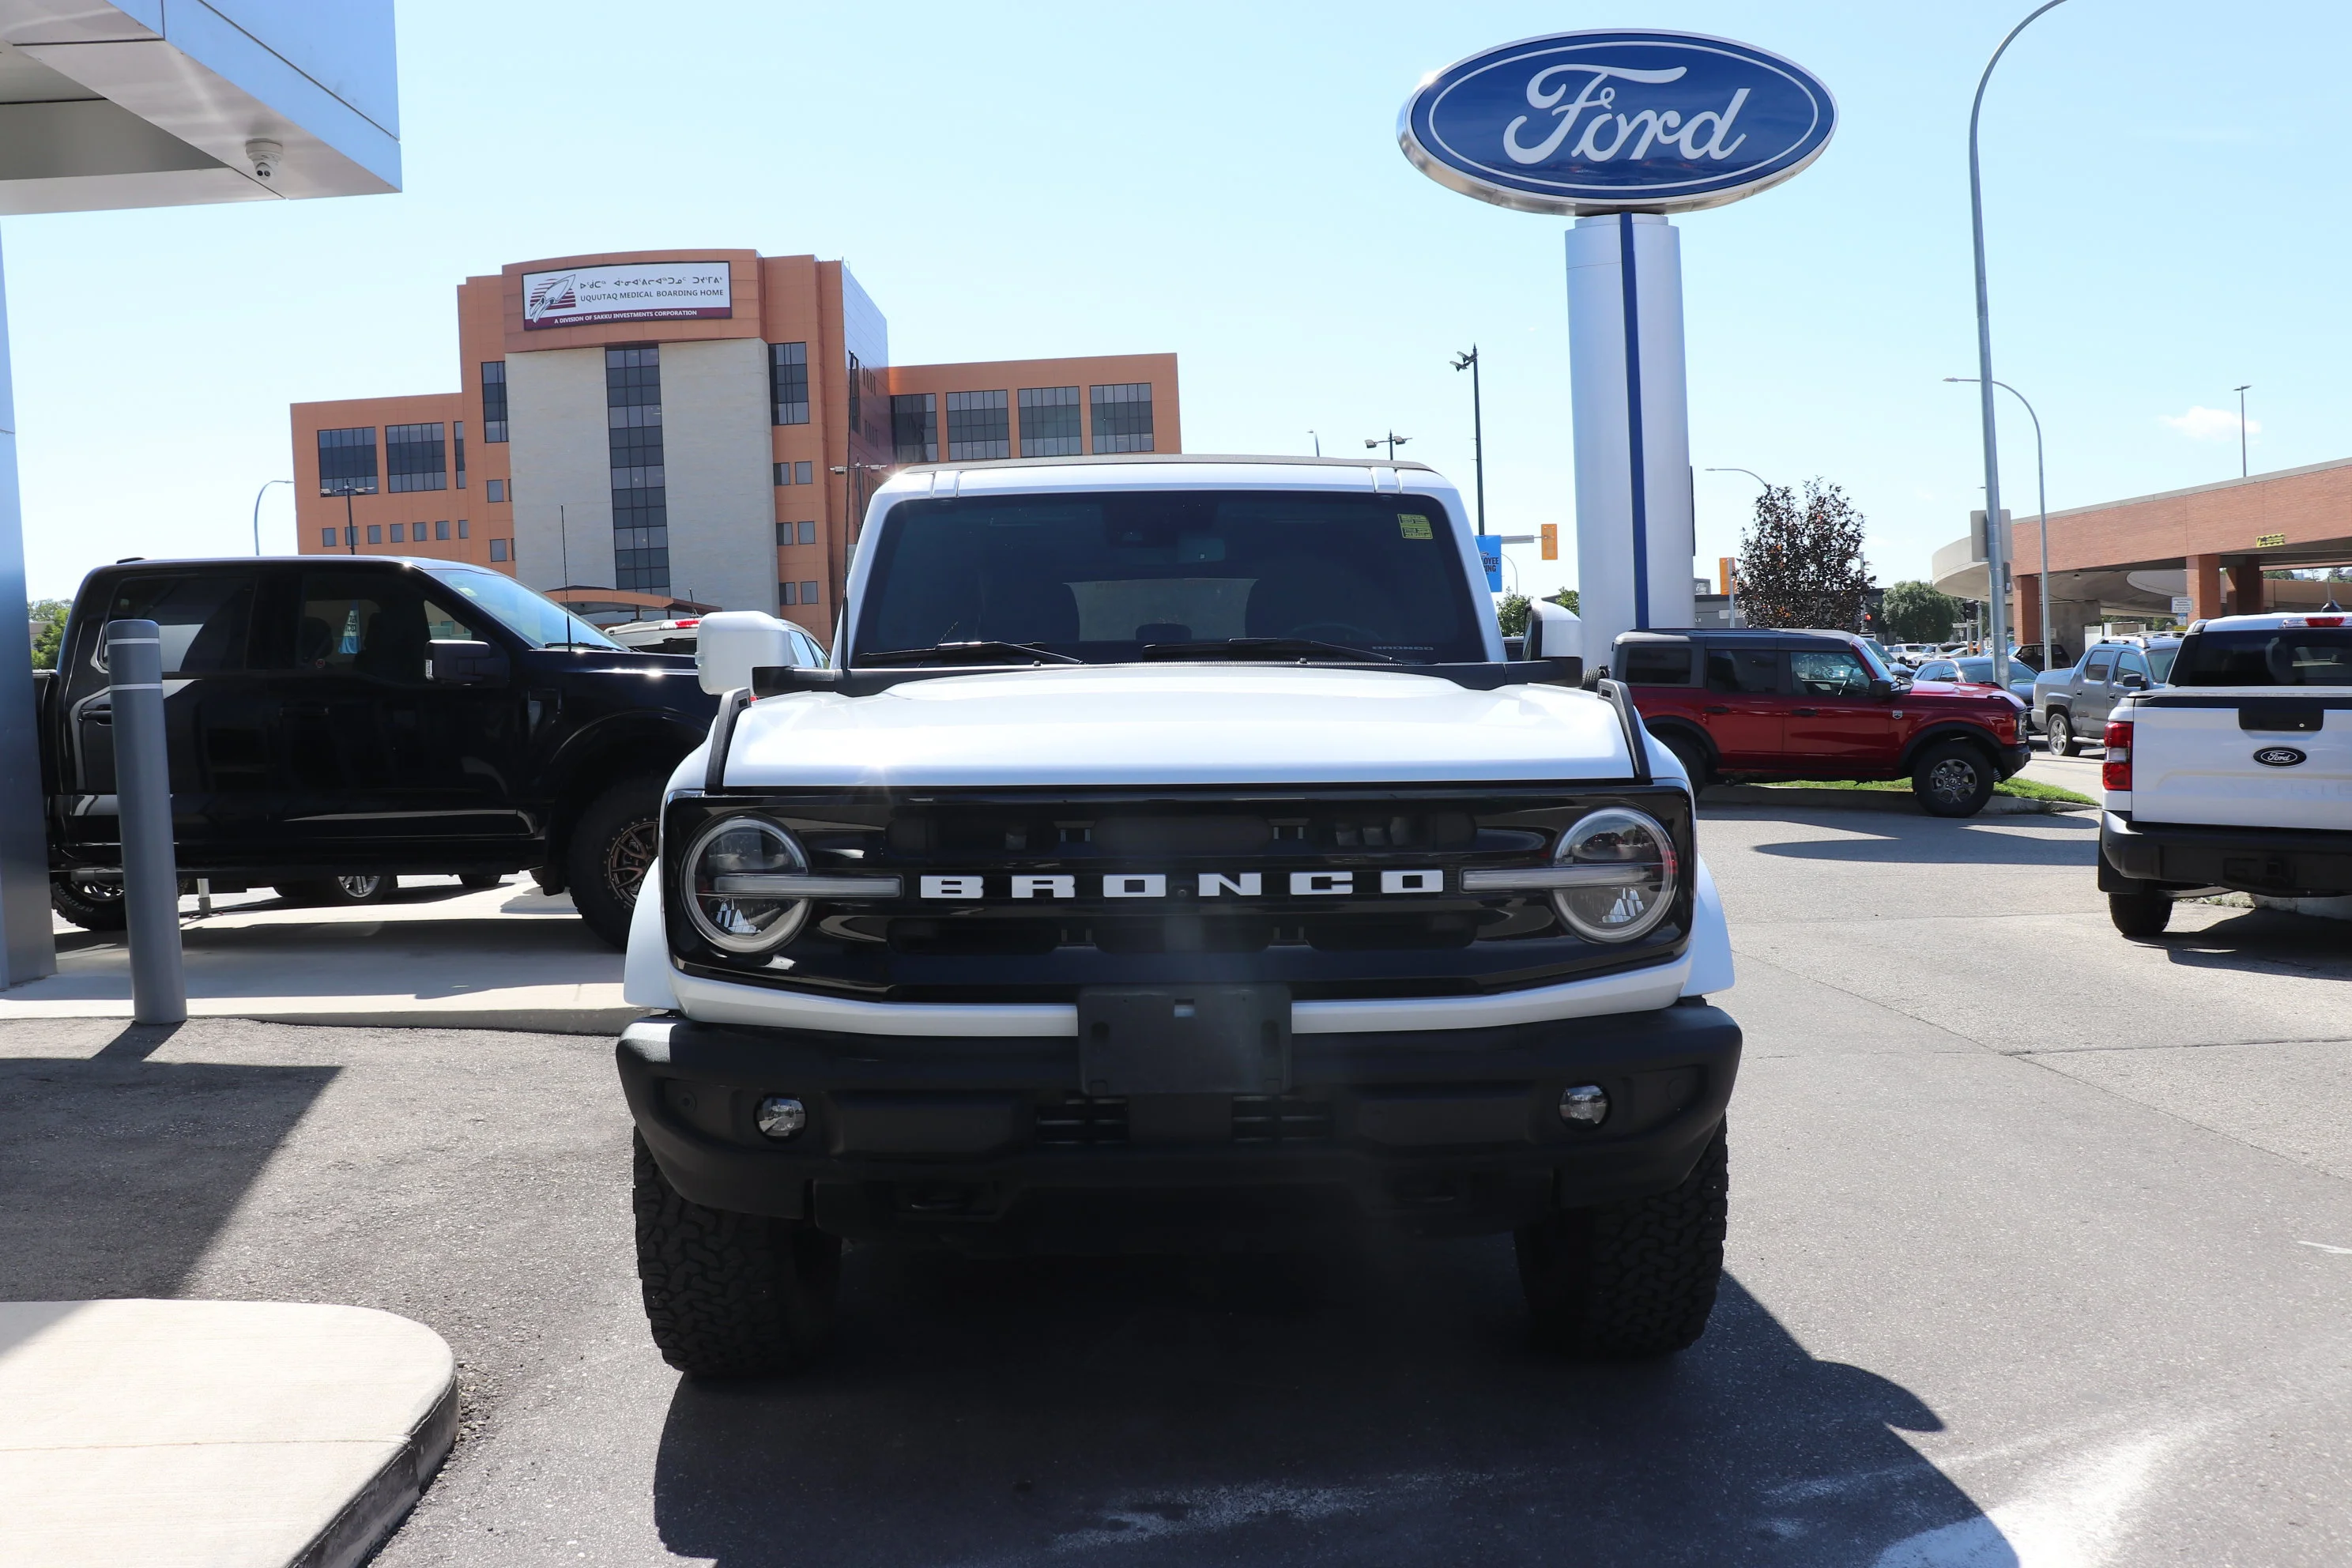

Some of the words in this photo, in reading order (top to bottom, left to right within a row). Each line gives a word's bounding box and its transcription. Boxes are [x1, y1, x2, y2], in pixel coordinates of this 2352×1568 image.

[1503, 63, 1751, 164] Ford
[580, 292, 618, 303] UQUUTAQ
[560, 315, 584, 324] DIVISION
[2267, 752, 2291, 761] Ford
[920, 870, 1444, 899] BRONCO
